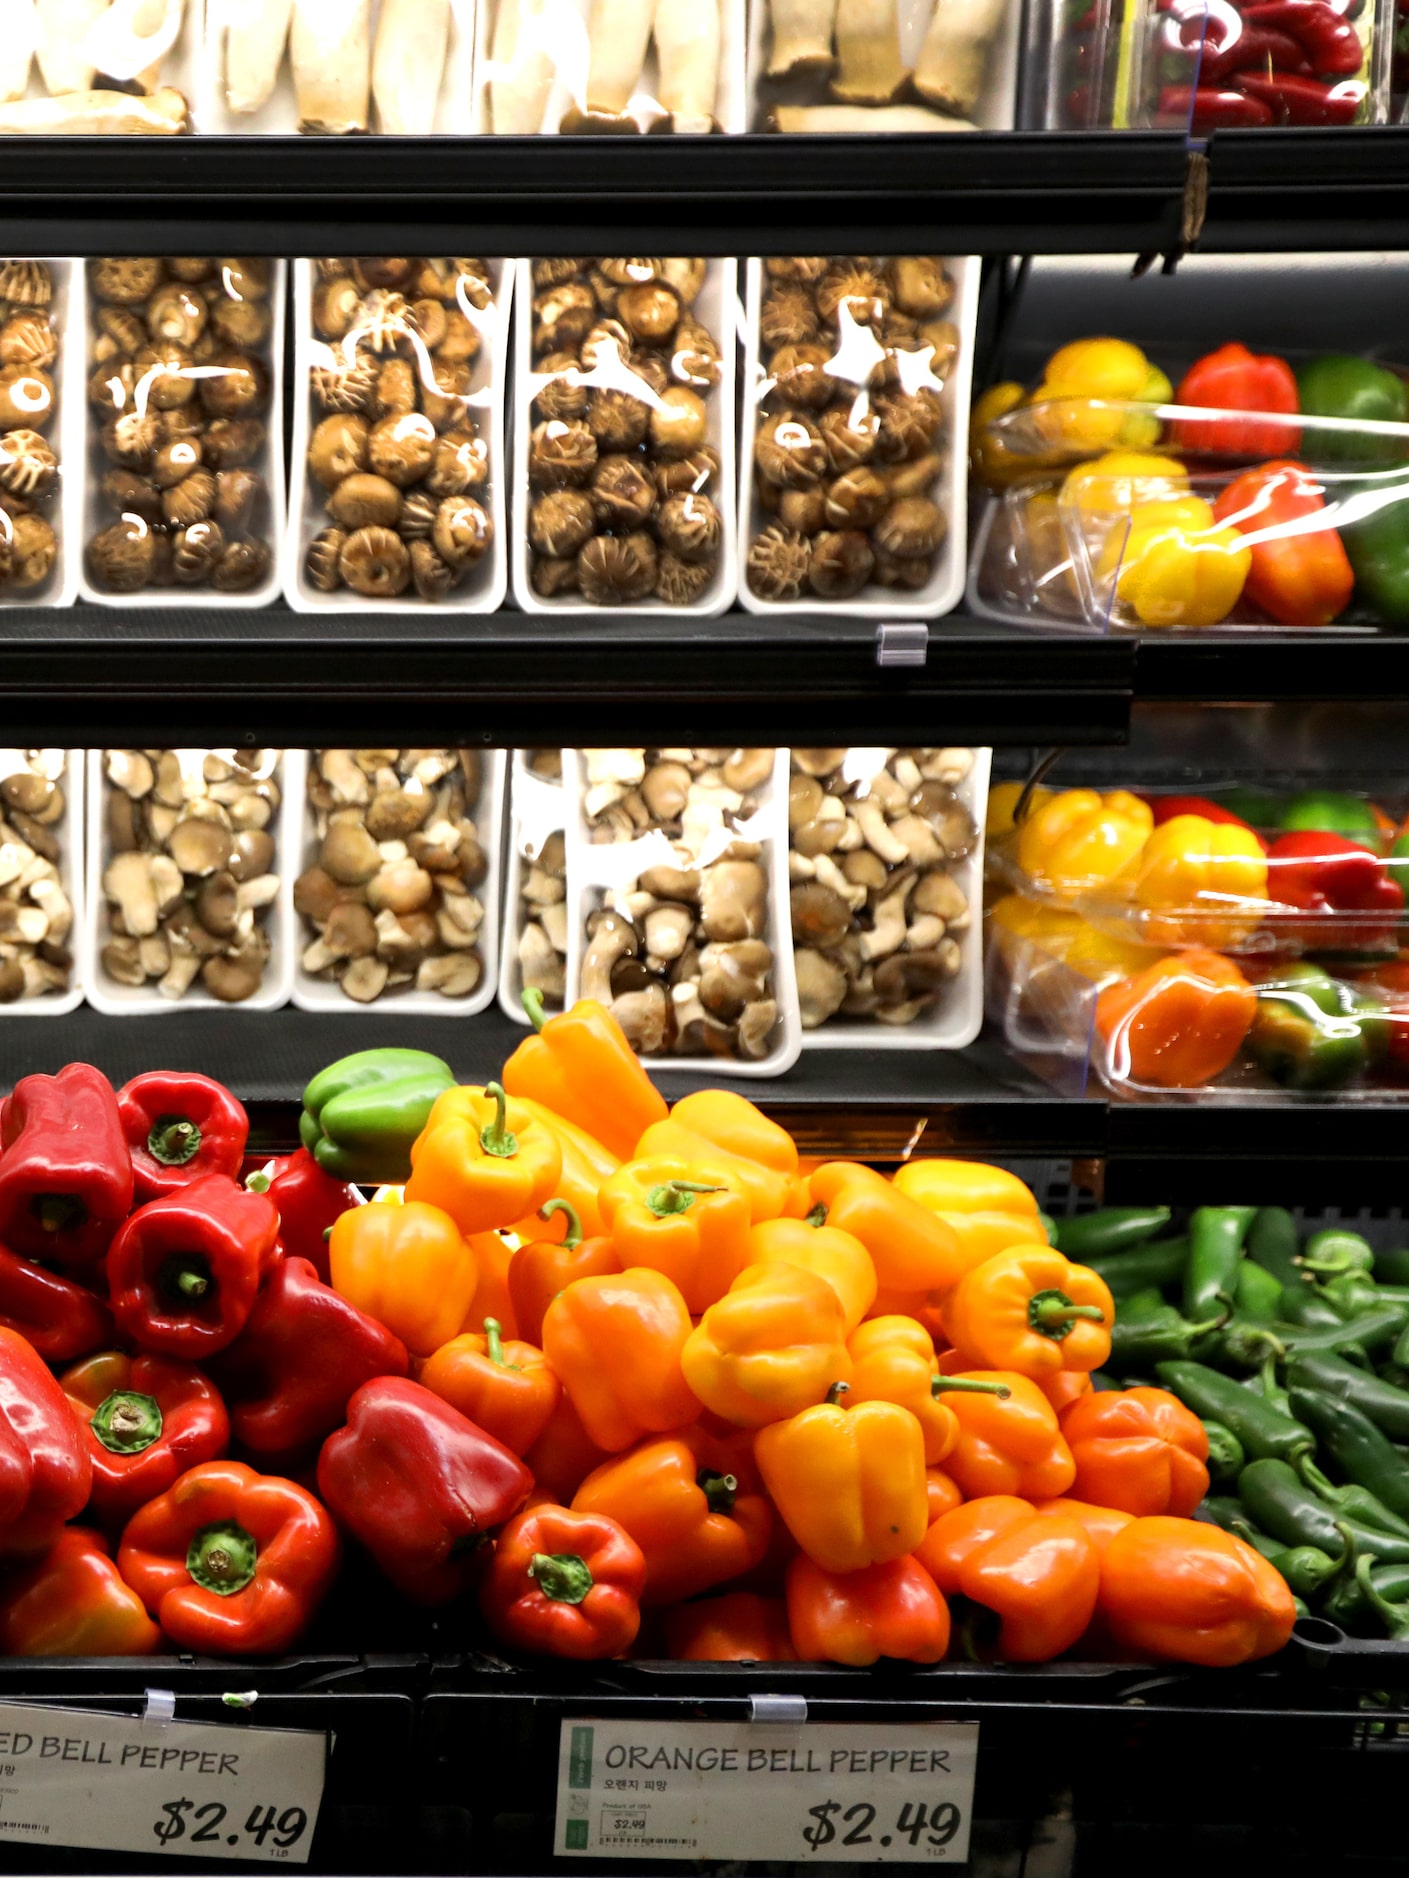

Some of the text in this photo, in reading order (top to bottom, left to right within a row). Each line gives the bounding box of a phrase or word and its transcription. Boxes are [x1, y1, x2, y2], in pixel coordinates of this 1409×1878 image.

[39, 1736, 113, 1764] BELL
[120, 1744, 240, 1775] PEPPER
[604, 1744, 951, 1773] ORANGE BELL PEPPER
[603, 1779, 668, 1792] 오렌지 피망
[153, 1796, 307, 1847] $2.49
[614, 1819, 646, 1830] $2.49
[803, 1799, 961, 1852] $2.49
